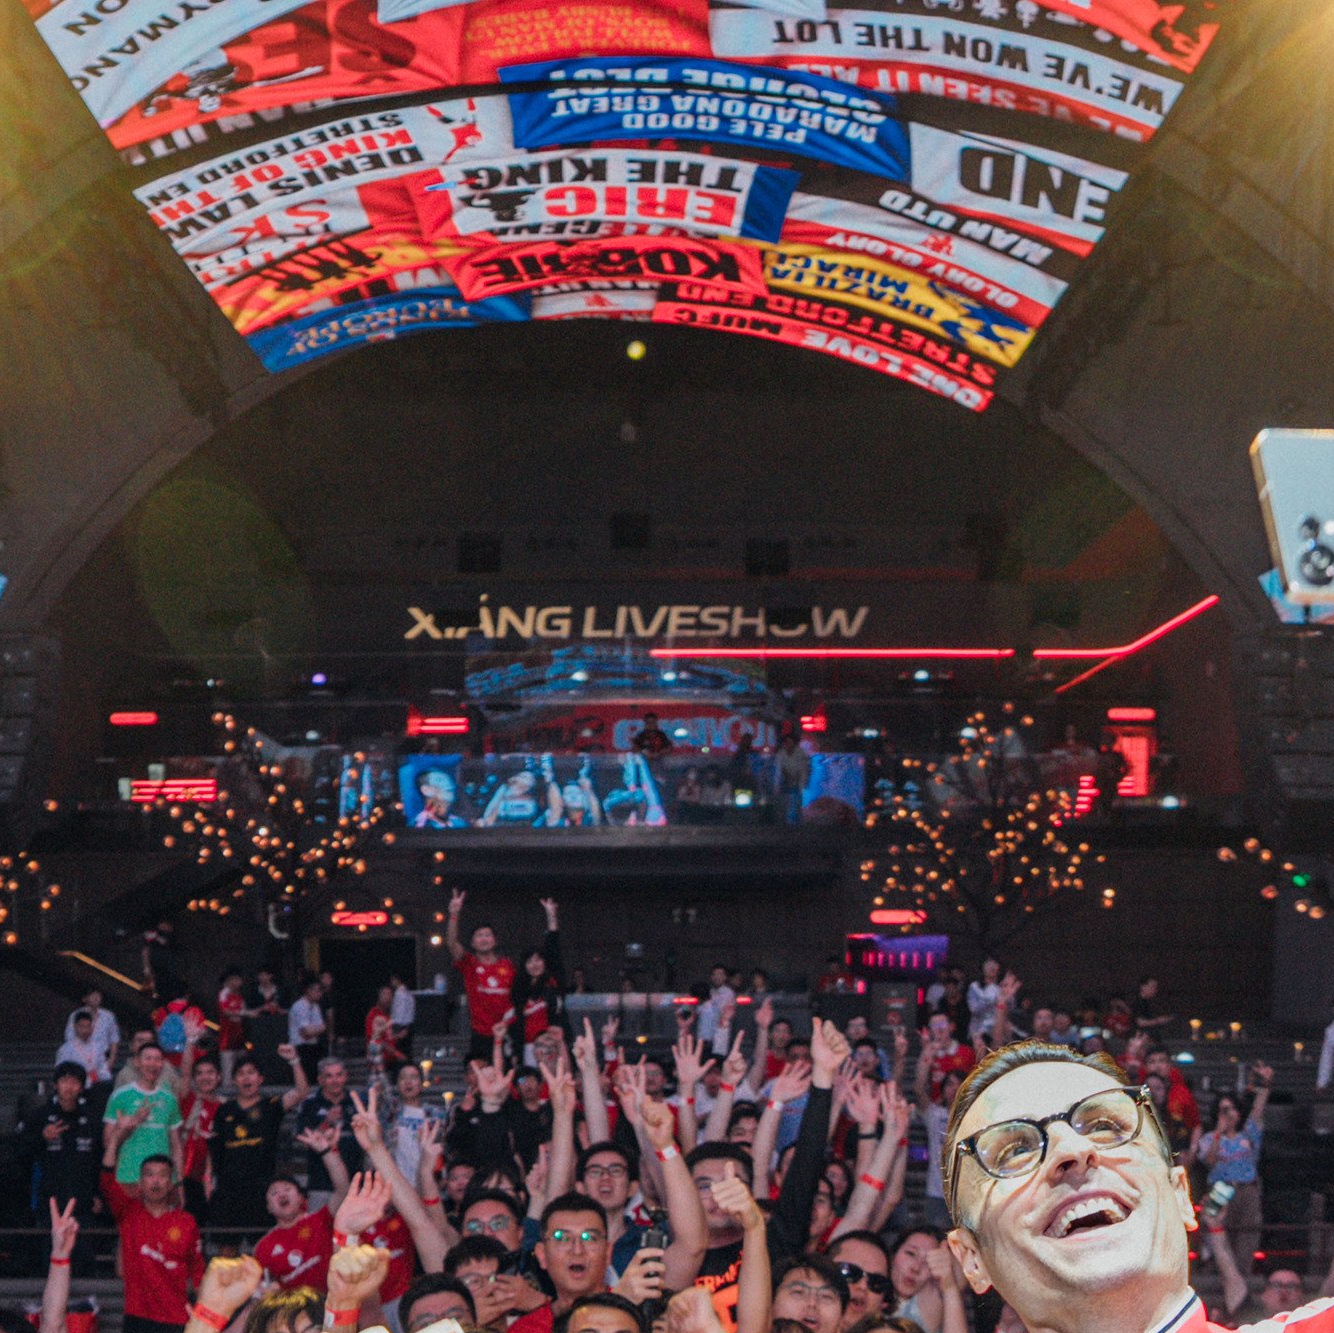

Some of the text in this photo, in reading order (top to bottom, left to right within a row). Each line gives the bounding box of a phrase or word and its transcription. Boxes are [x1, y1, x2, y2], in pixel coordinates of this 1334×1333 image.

[772, 19, 1164, 116] WE'VE WON THE LOT
[785, 61, 860, 87] AL
[550, 93, 879, 145] MARADONA GREAT
[622, 111, 807, 145] PELE GOOD
[194, 112, 401, 185] STRETFORD
[292, 126, 415, 171] KING
[167, 146, 424, 242] DENIS LAW
[229, 163, 285, 194] OF
[459, 156, 744, 193] THE KING
[543, 186, 737, 228] ERIC
[876, 188, 1054, 267] MAN UTD
[761, 250, 909, 295] MIRACL
[670, 307, 983, 410] ONE LOVE MUFC
[404, 604, 870, 640] XANG LIVESHW
